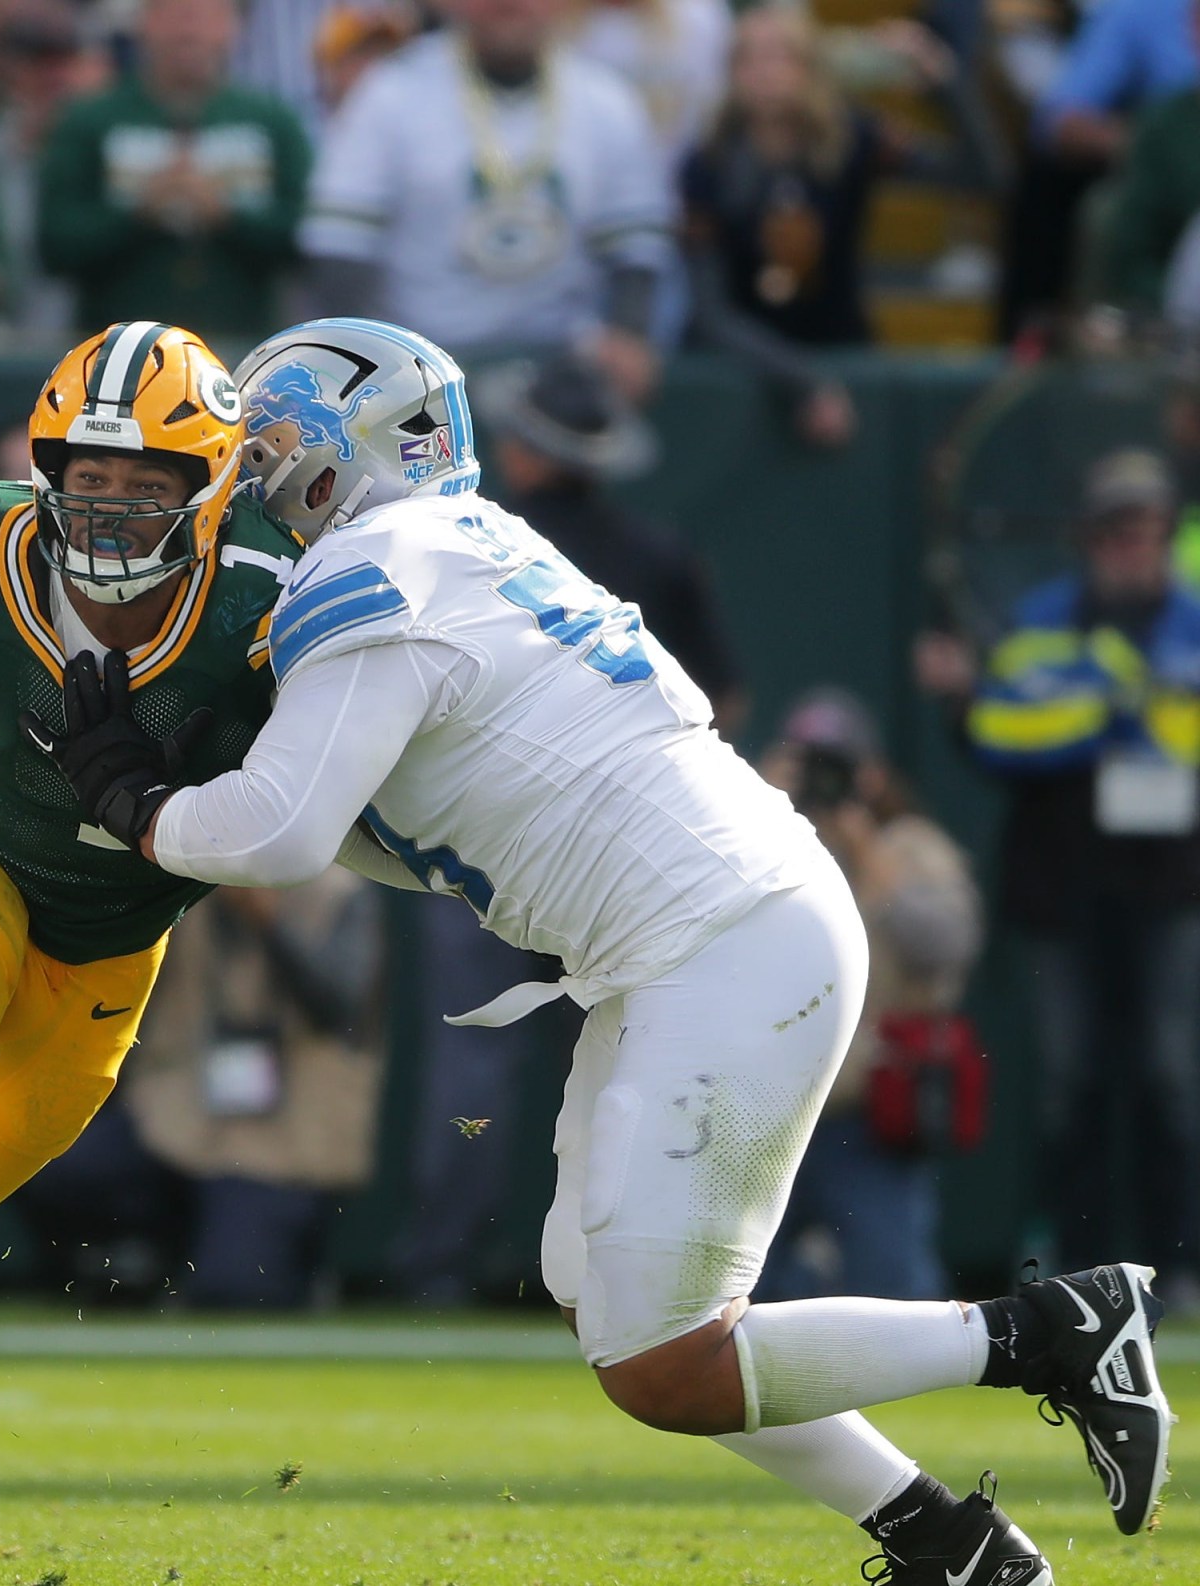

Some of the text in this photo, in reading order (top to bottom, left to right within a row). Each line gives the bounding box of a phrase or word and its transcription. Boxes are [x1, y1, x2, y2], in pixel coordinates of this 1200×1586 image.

[85, 420, 122, 433] PACKERS
[439, 470, 480, 496] DETR
[220, 544, 294, 586] 1
